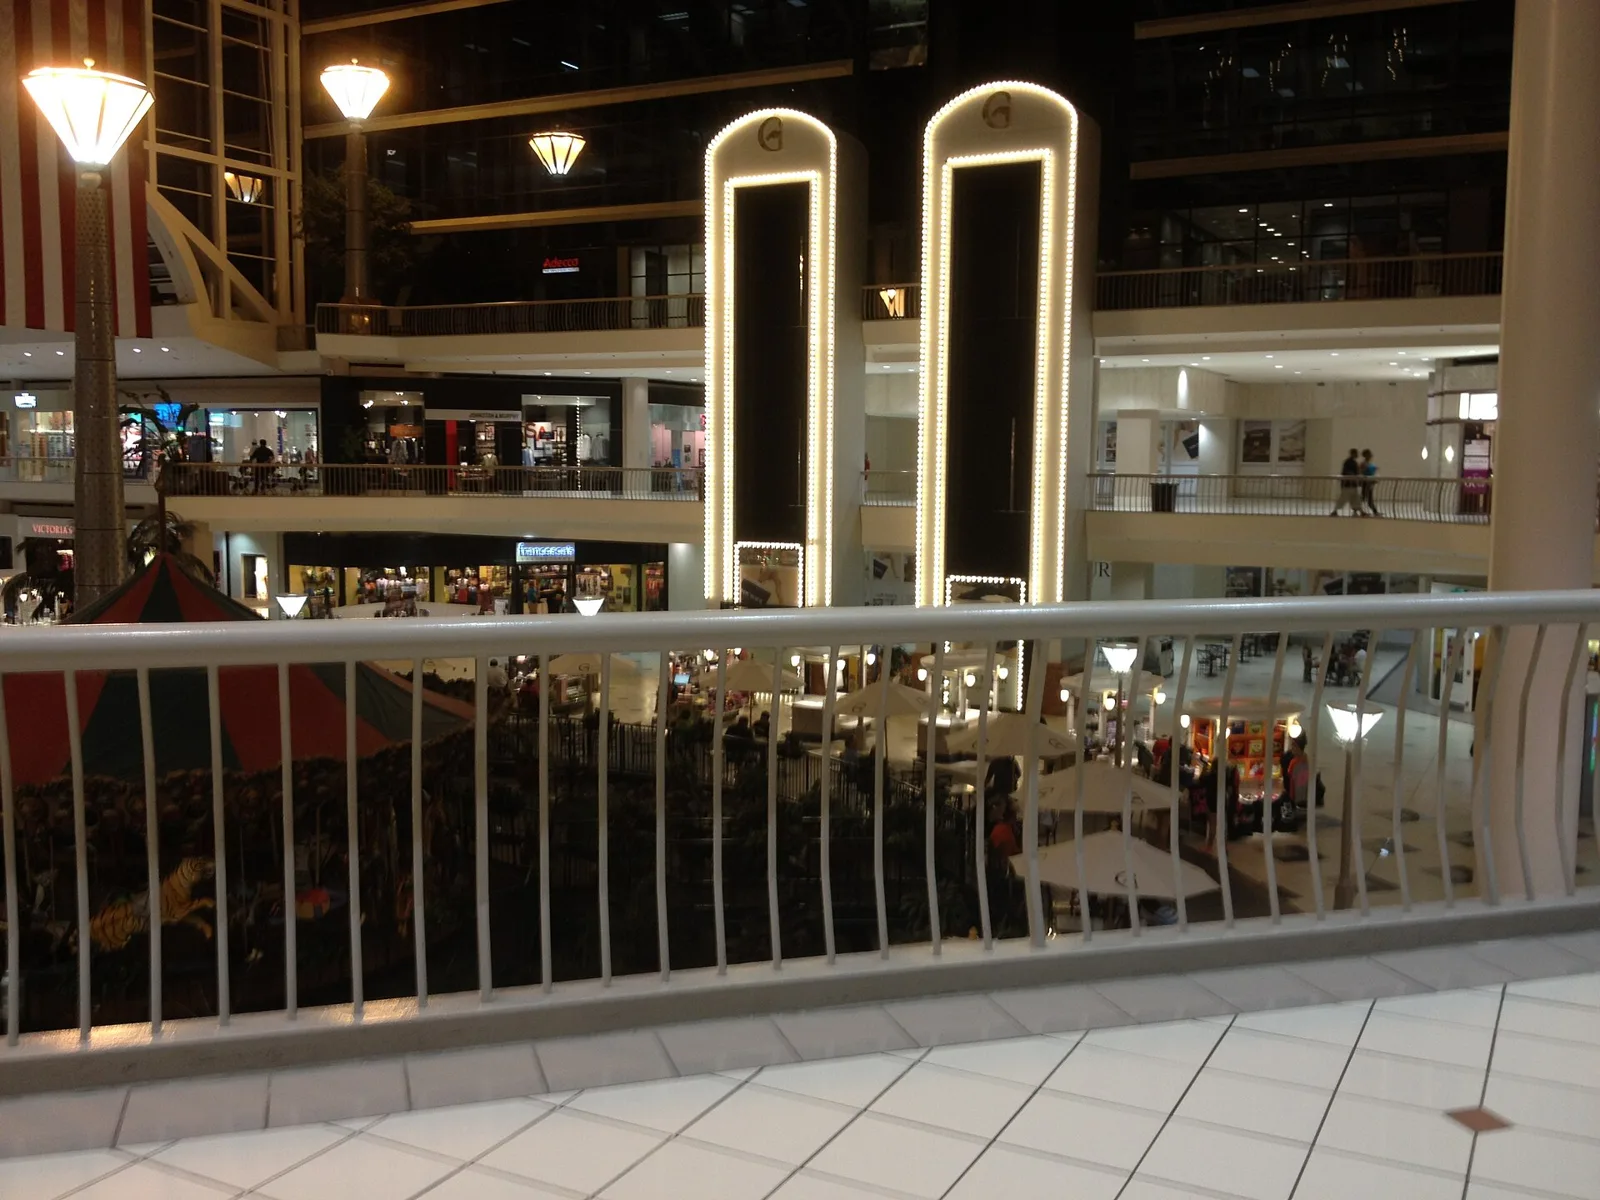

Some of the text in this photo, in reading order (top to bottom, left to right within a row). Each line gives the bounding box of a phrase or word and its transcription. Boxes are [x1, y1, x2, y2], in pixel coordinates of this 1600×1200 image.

[980, 91, 1012, 129] G
[757, 116, 784, 151] G
[543, 256, 579, 268] Adecco
